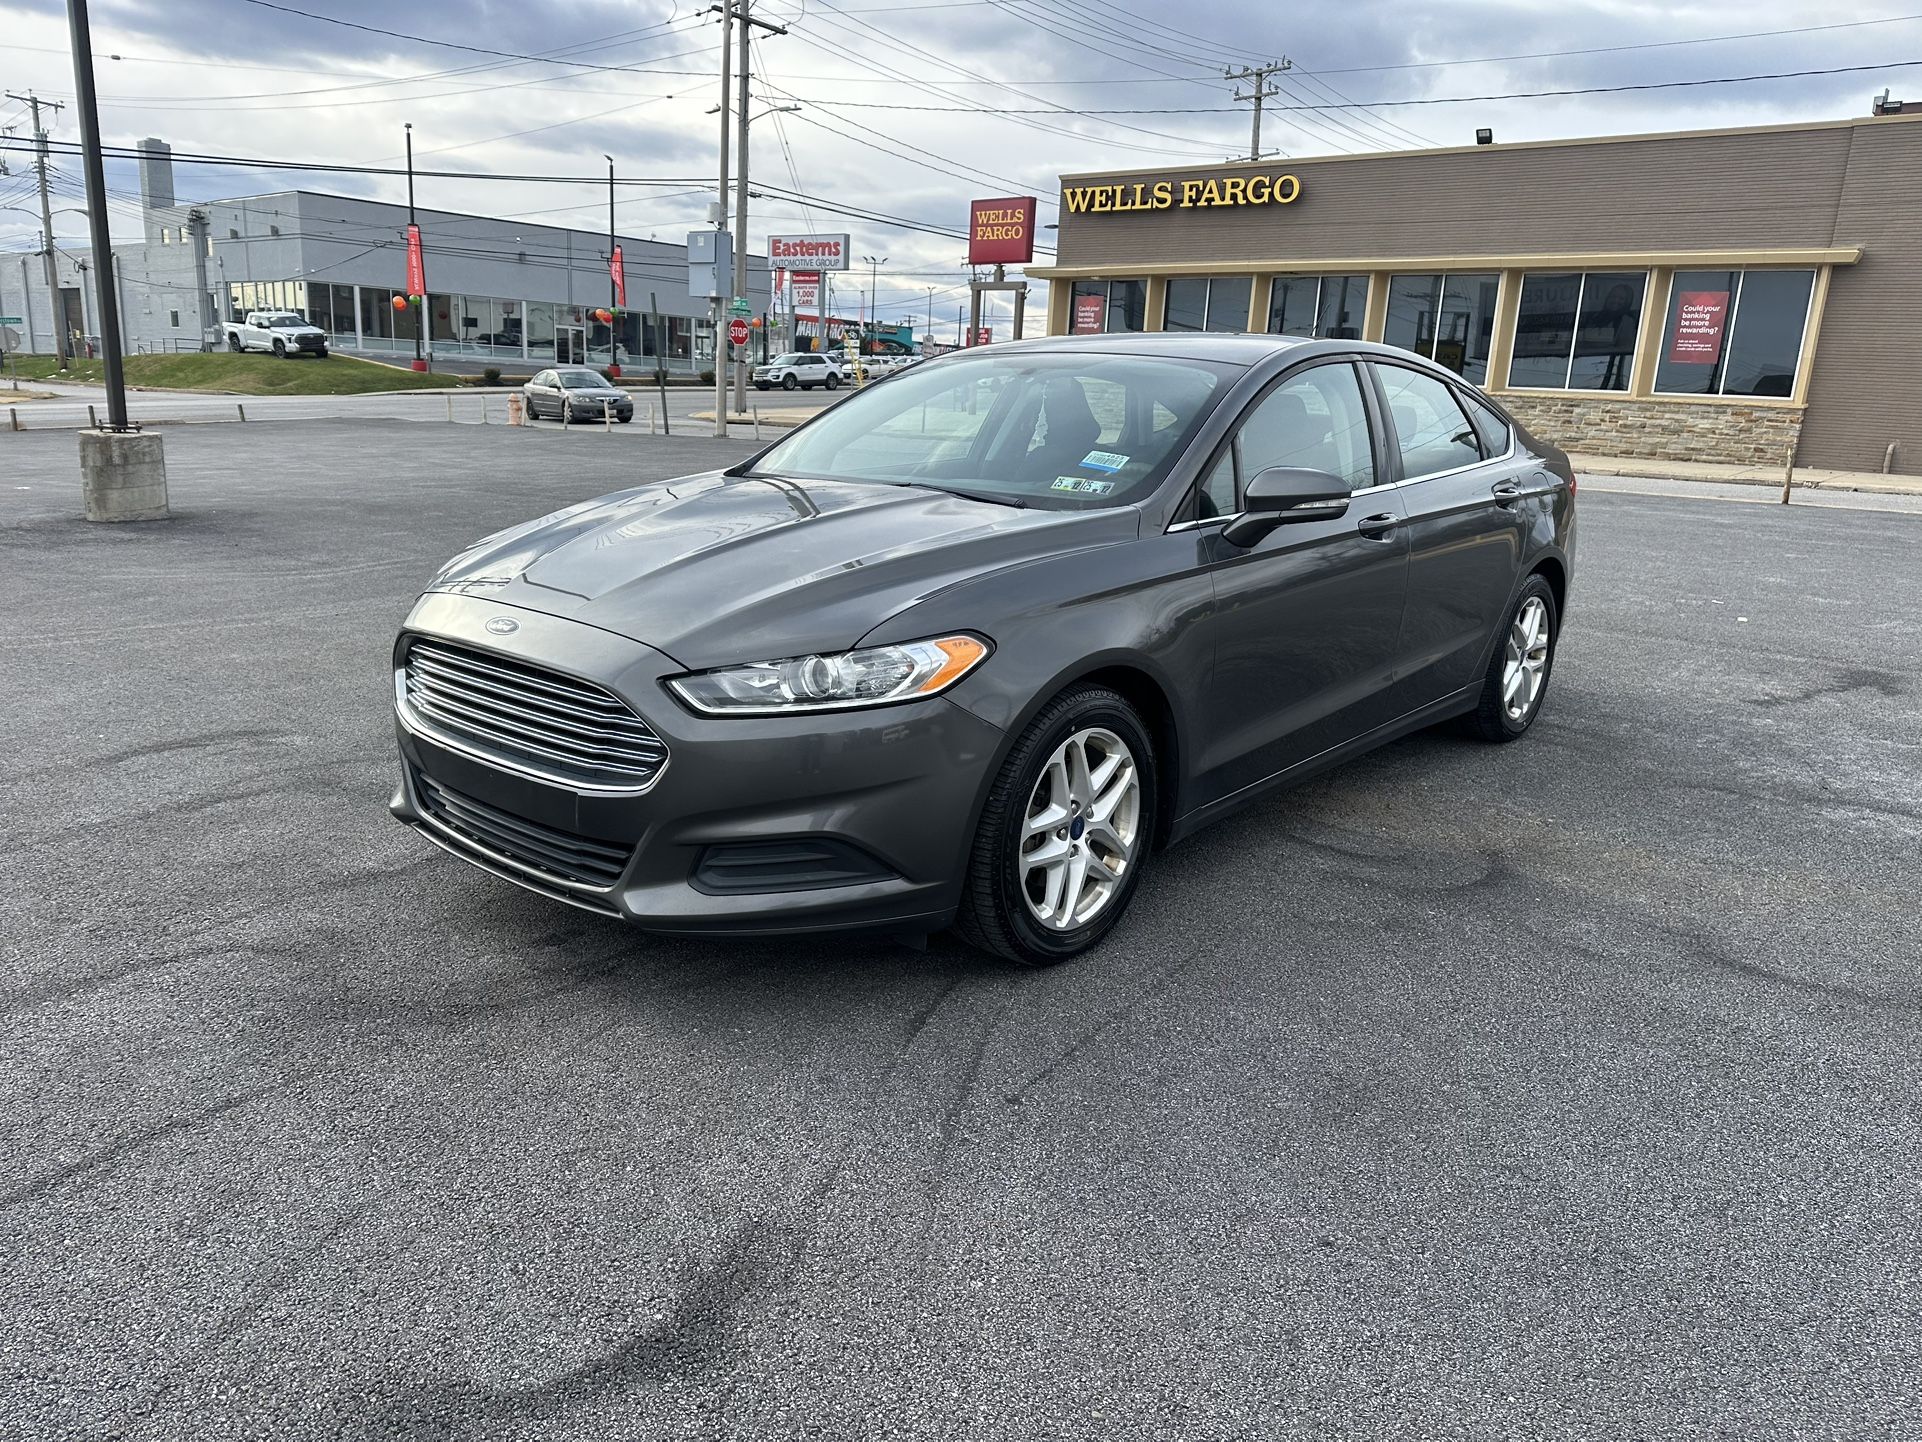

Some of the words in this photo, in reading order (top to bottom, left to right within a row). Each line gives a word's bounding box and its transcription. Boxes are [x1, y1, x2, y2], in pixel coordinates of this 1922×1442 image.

[1063, 181, 1172, 213] WELLS
[1179, 174, 1301, 208] FARGO
[976, 209, 1024, 224] WELLS
[976, 225, 1023, 240] FARGO
[771, 239, 841, 257] Easterns
[771, 259, 814, 267] AUTOMOTIVE
[815, 258, 840, 267] GROUP
[797, 290, 815, 299] 1,000
[1682, 312, 1710, 320] banking
[730, 326, 748, 338] STOP
[1679, 327, 1719, 335] rewarding?
